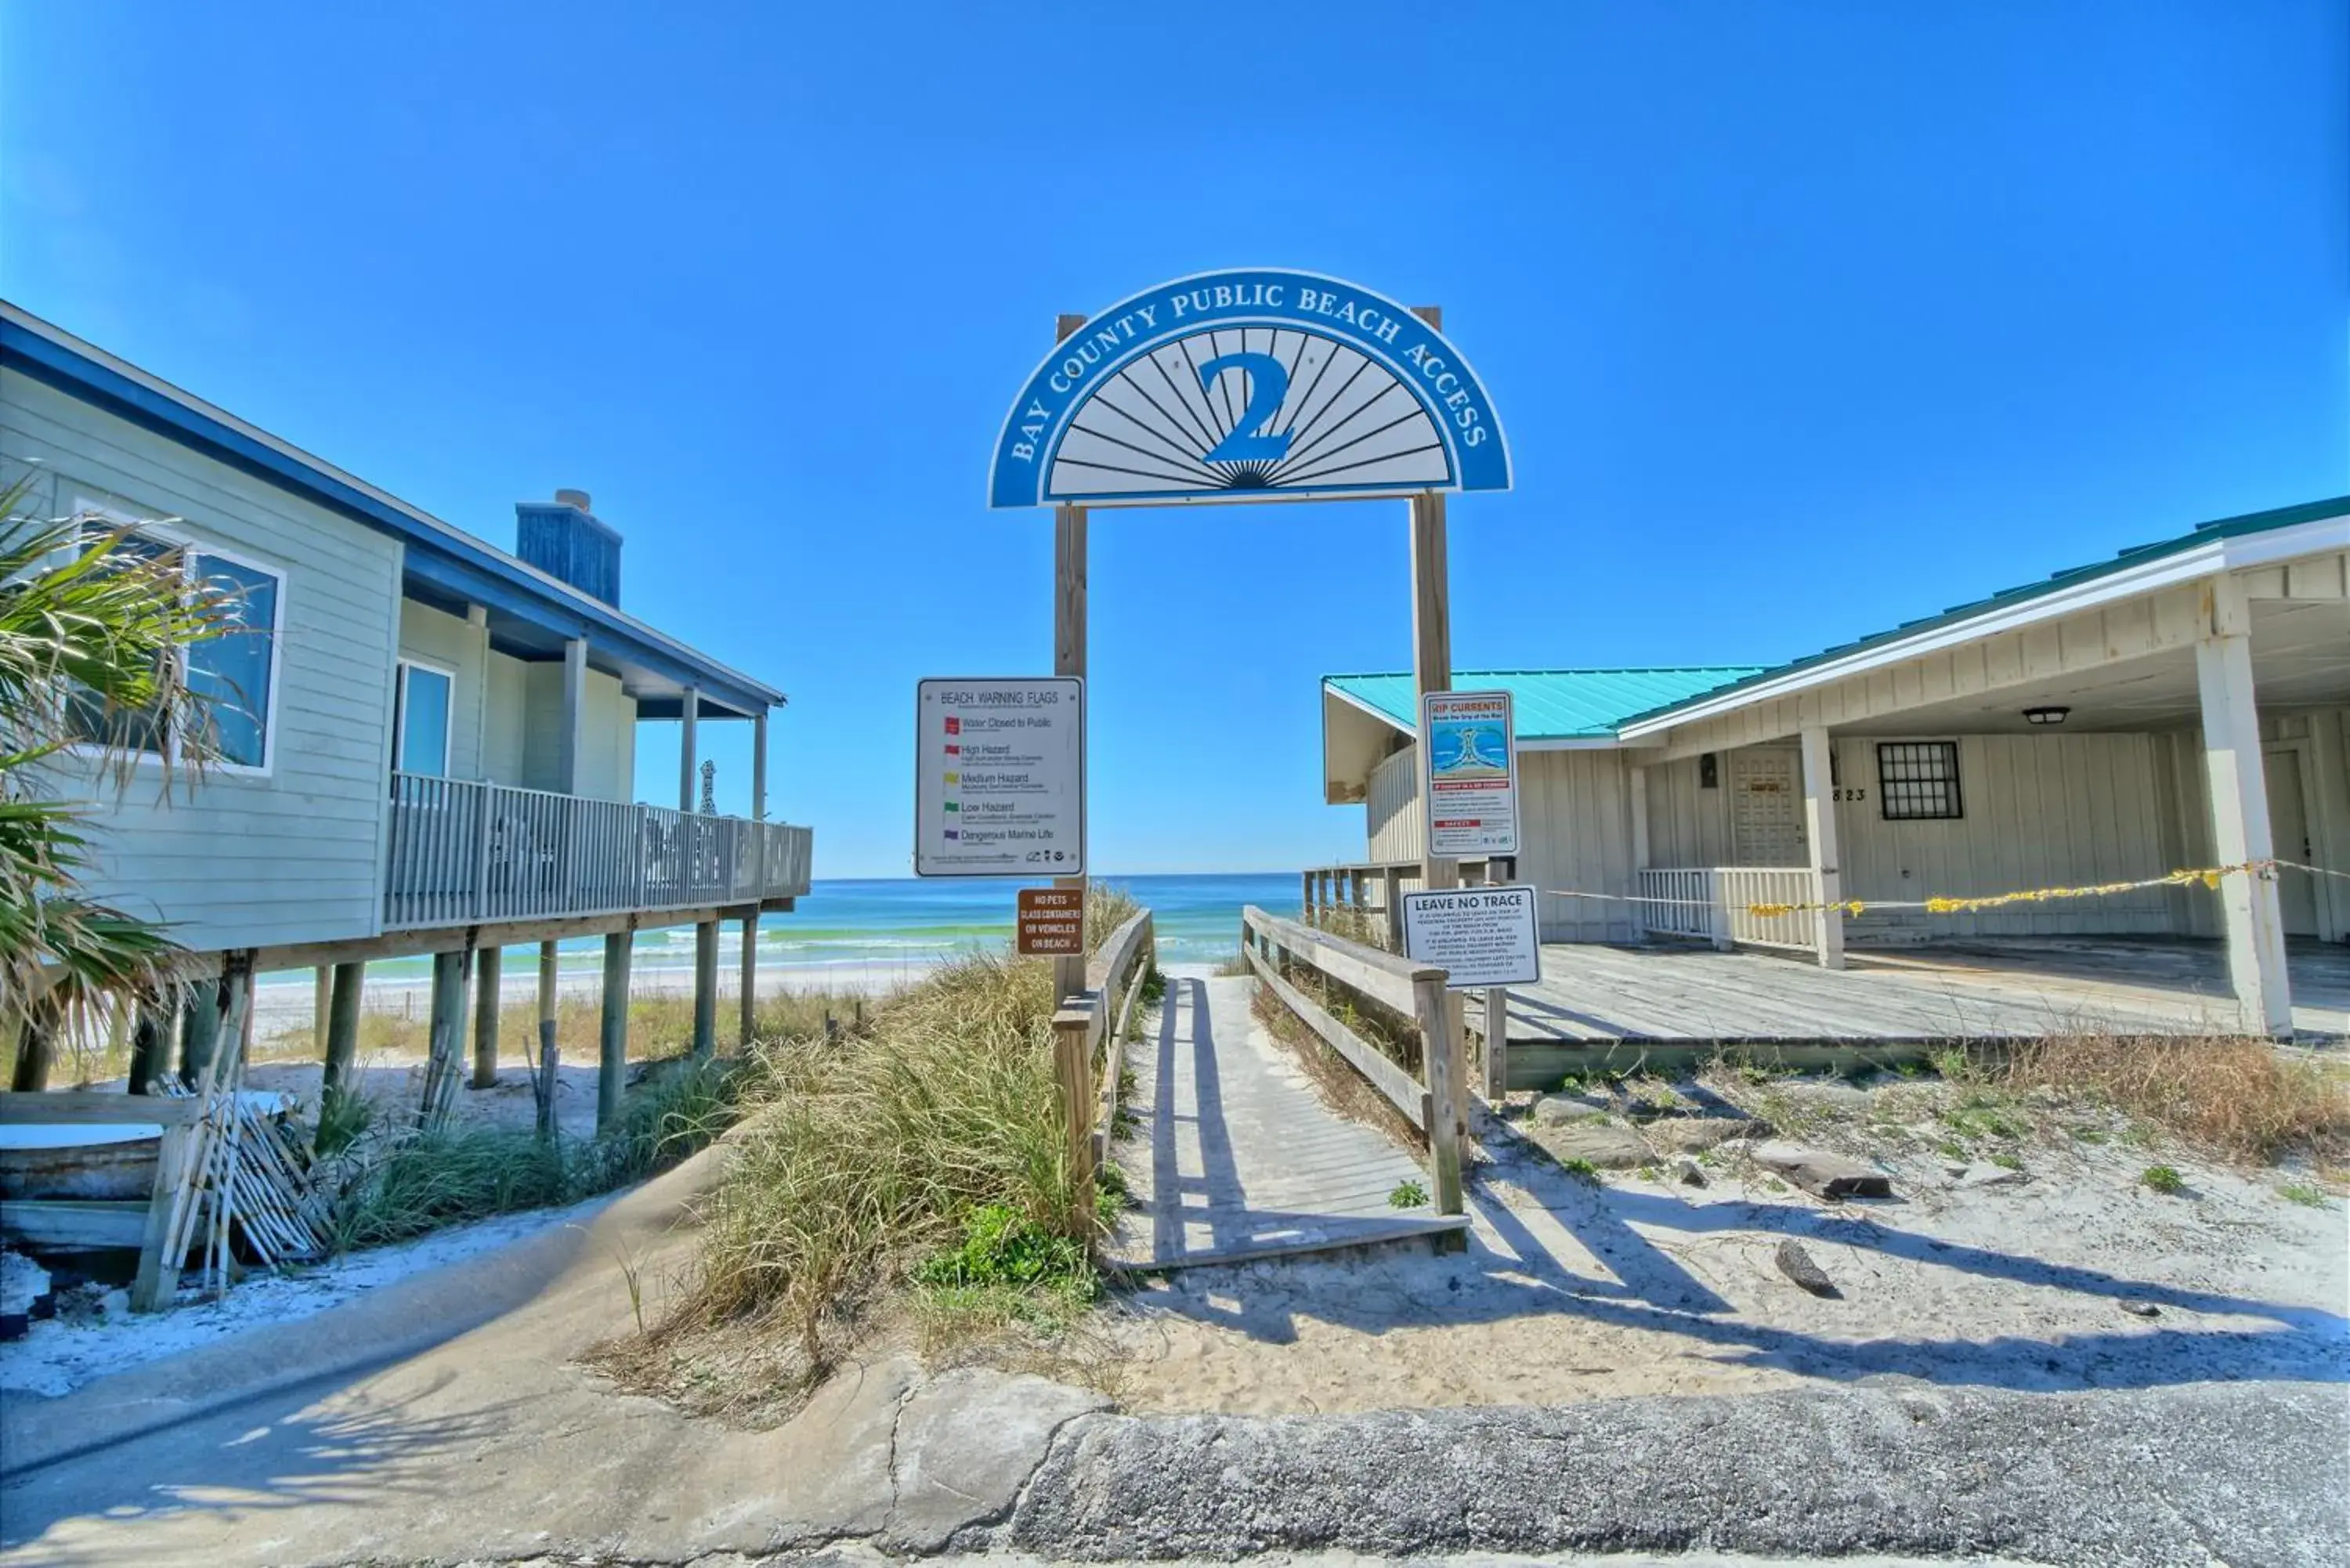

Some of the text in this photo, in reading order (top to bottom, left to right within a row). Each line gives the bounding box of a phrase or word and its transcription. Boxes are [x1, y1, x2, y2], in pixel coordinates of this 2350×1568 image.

[1012, 284, 1487, 463] BAY COUNTY PUBLIC BEACH ACCESS
[1198, 352, 1296, 463] 2
[941, 691, 1058, 704] BEACH WARNING FLAGS
[1432, 702, 1503, 713] RIP CURRENTS
[963, 717, 1052, 728] Water Closed to Public
[962, 744, 1010, 755] High Hazard
[962, 773, 1029, 782] Medium Hazard
[962, 802, 1014, 811] Low Hazard
[962, 829, 1054, 842] Dangerous Marine Life
[1035, 895, 1068, 905] NO PETS
[1415, 895, 1523, 911] LEAVE NO TRACE
[1038, 923, 1076, 934] VEHICLES
[1031, 939, 1071, 949] ON BEACH
